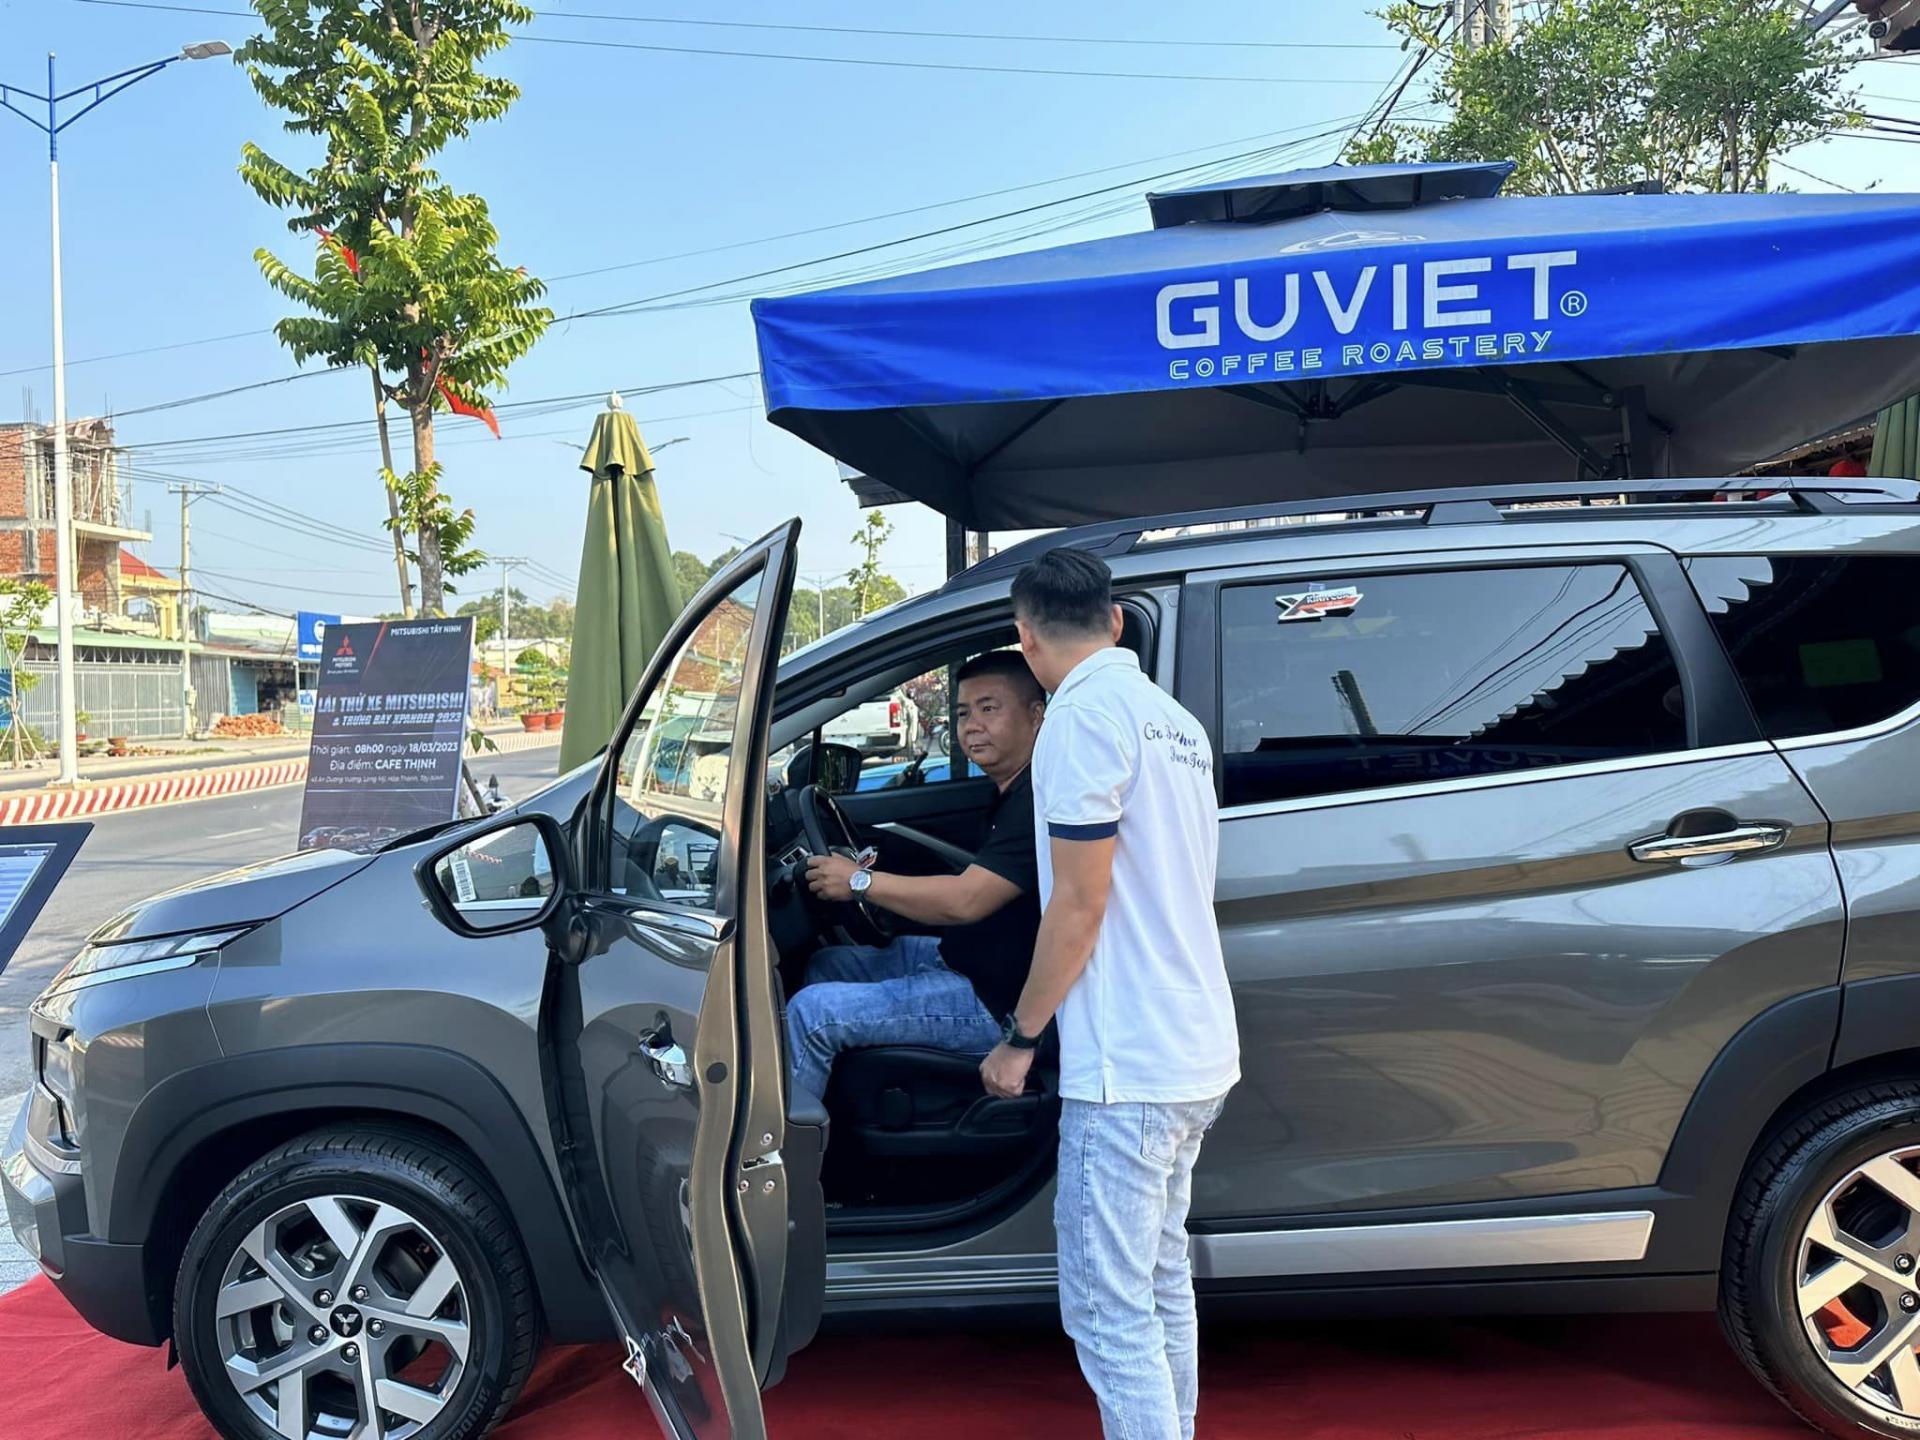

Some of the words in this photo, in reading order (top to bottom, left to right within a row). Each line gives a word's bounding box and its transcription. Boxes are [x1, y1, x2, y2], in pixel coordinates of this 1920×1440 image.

[1156, 250, 1577, 350] GUVIET
[1169, 347, 1322, 380] COFFEE
[1342, 330, 1553, 366] ROASTERY
[390, 626, 429, 637] MITSUBISHI
[367, 695, 382, 711] XE
[385, 691, 465, 711] MITSUBISHI
[435, 711, 462, 723] 2023
[354, 743, 384, 754] 08h00
[408, 740, 459, 753] 18/03/2023
[375, 758, 402, 770] CAFE
